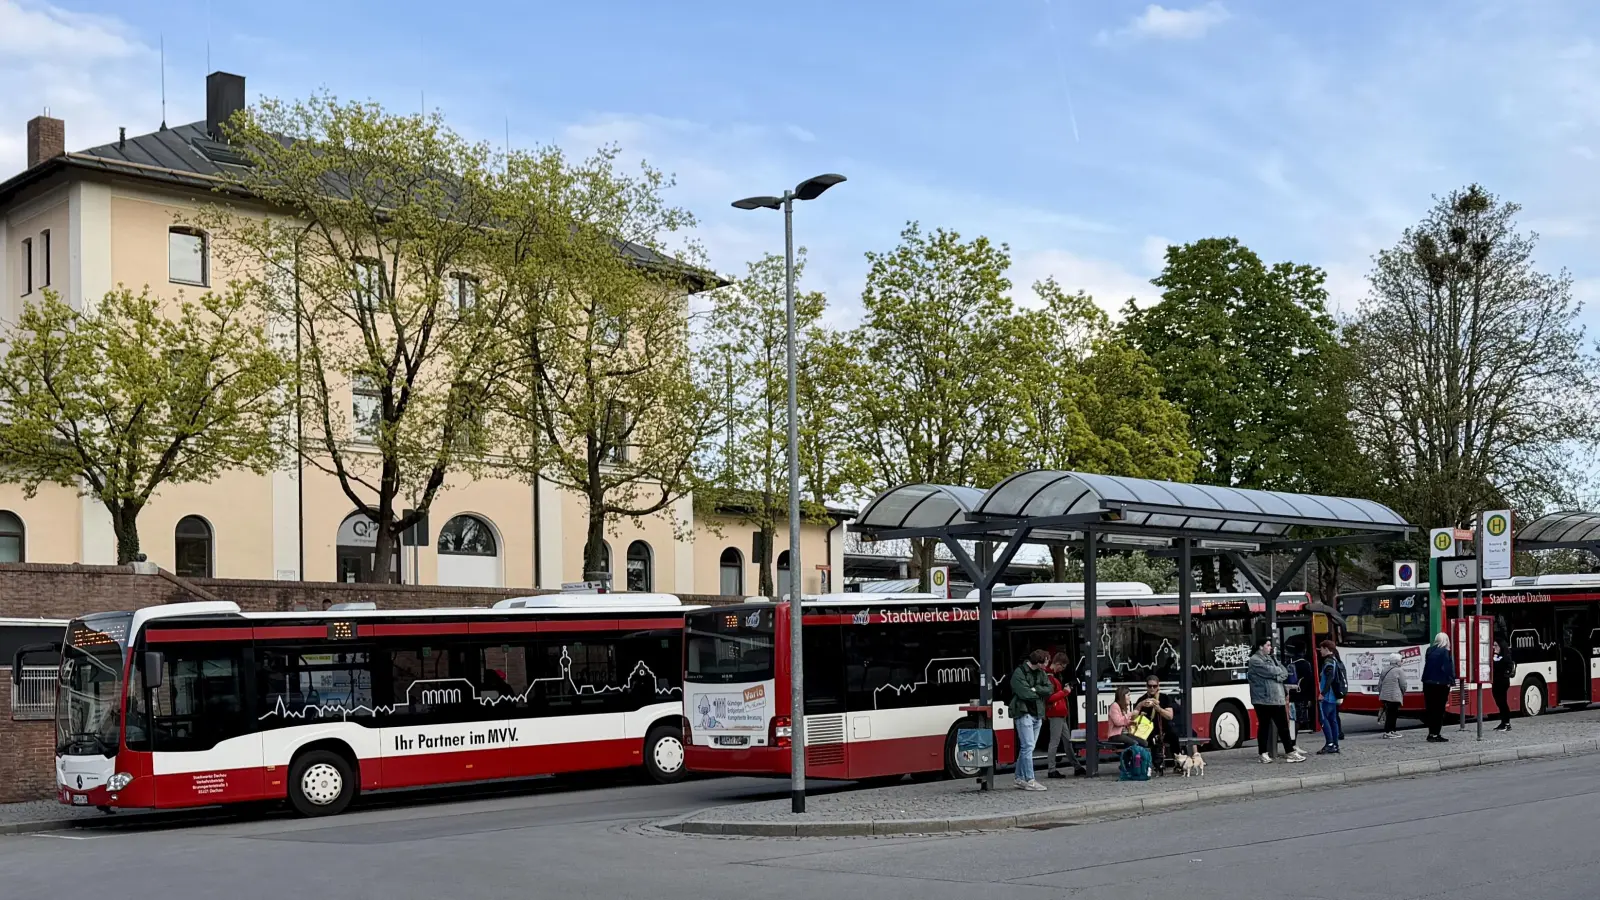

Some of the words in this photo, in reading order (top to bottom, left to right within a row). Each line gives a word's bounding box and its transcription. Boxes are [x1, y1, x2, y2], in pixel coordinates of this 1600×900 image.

[1492, 519, 1502, 532] H
[1438, 536, 1447, 547] H
[1489, 592, 1526, 604] Stadtwerke
[1526, 591, 1551, 603] Dachau
[880, 607, 950, 624] Stadtwerke
[952, 606, 998, 622] Dacu
[744, 688, 764, 701] Vario
[1098, 699, 1111, 716] Ih
[394, 734, 414, 751] Ihr
[418, 733, 465, 749] Partner
[469, 731, 485, 745] im
[487, 727, 519, 744] MVV.
